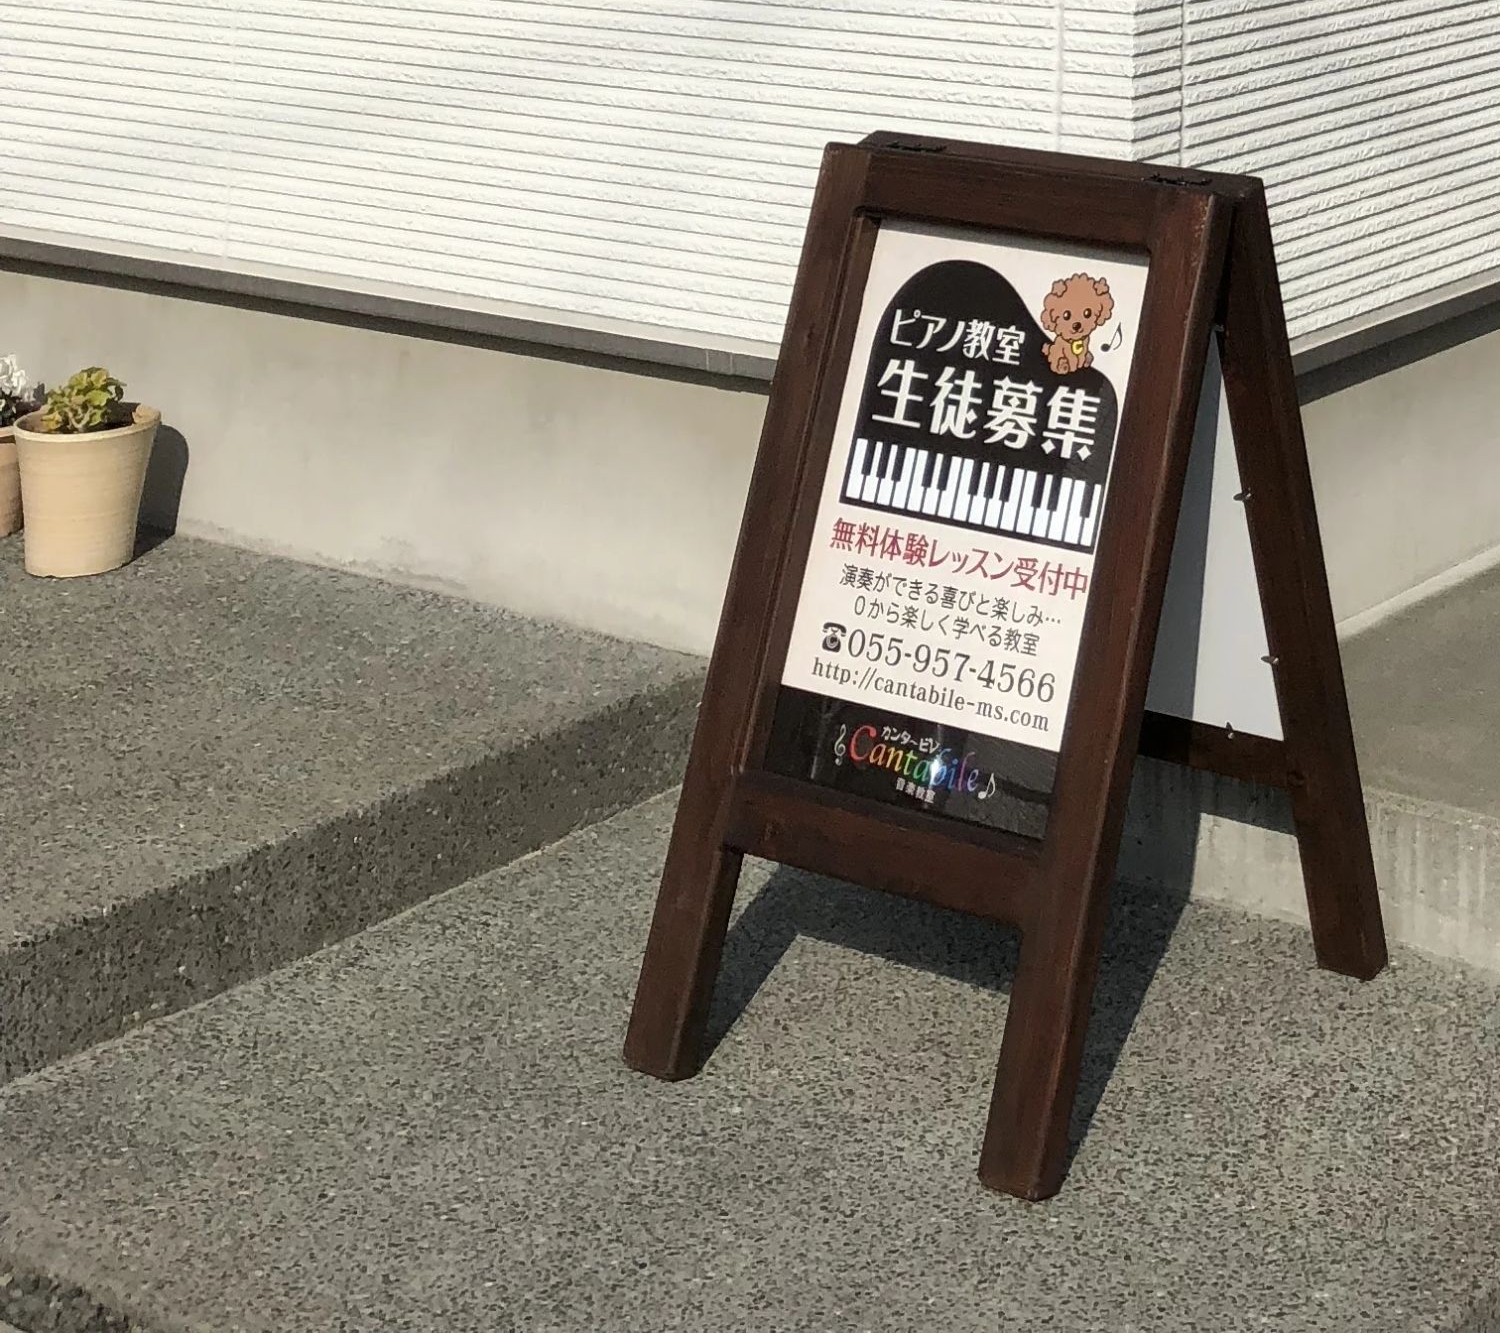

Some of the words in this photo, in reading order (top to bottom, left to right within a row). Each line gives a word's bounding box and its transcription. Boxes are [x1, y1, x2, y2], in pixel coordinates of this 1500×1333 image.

[890, 309, 1025, 365] ピアノ教室
[872, 359, 1101, 460] 生徒募集
[829, 517, 1089, 600] 無料体験レッスン受付中
[812, 657, 1049, 731] http://cantabile-ms.com
[848, 629, 1056, 702] 055-957-4566
[850, 725, 979, 793] Cantabile
